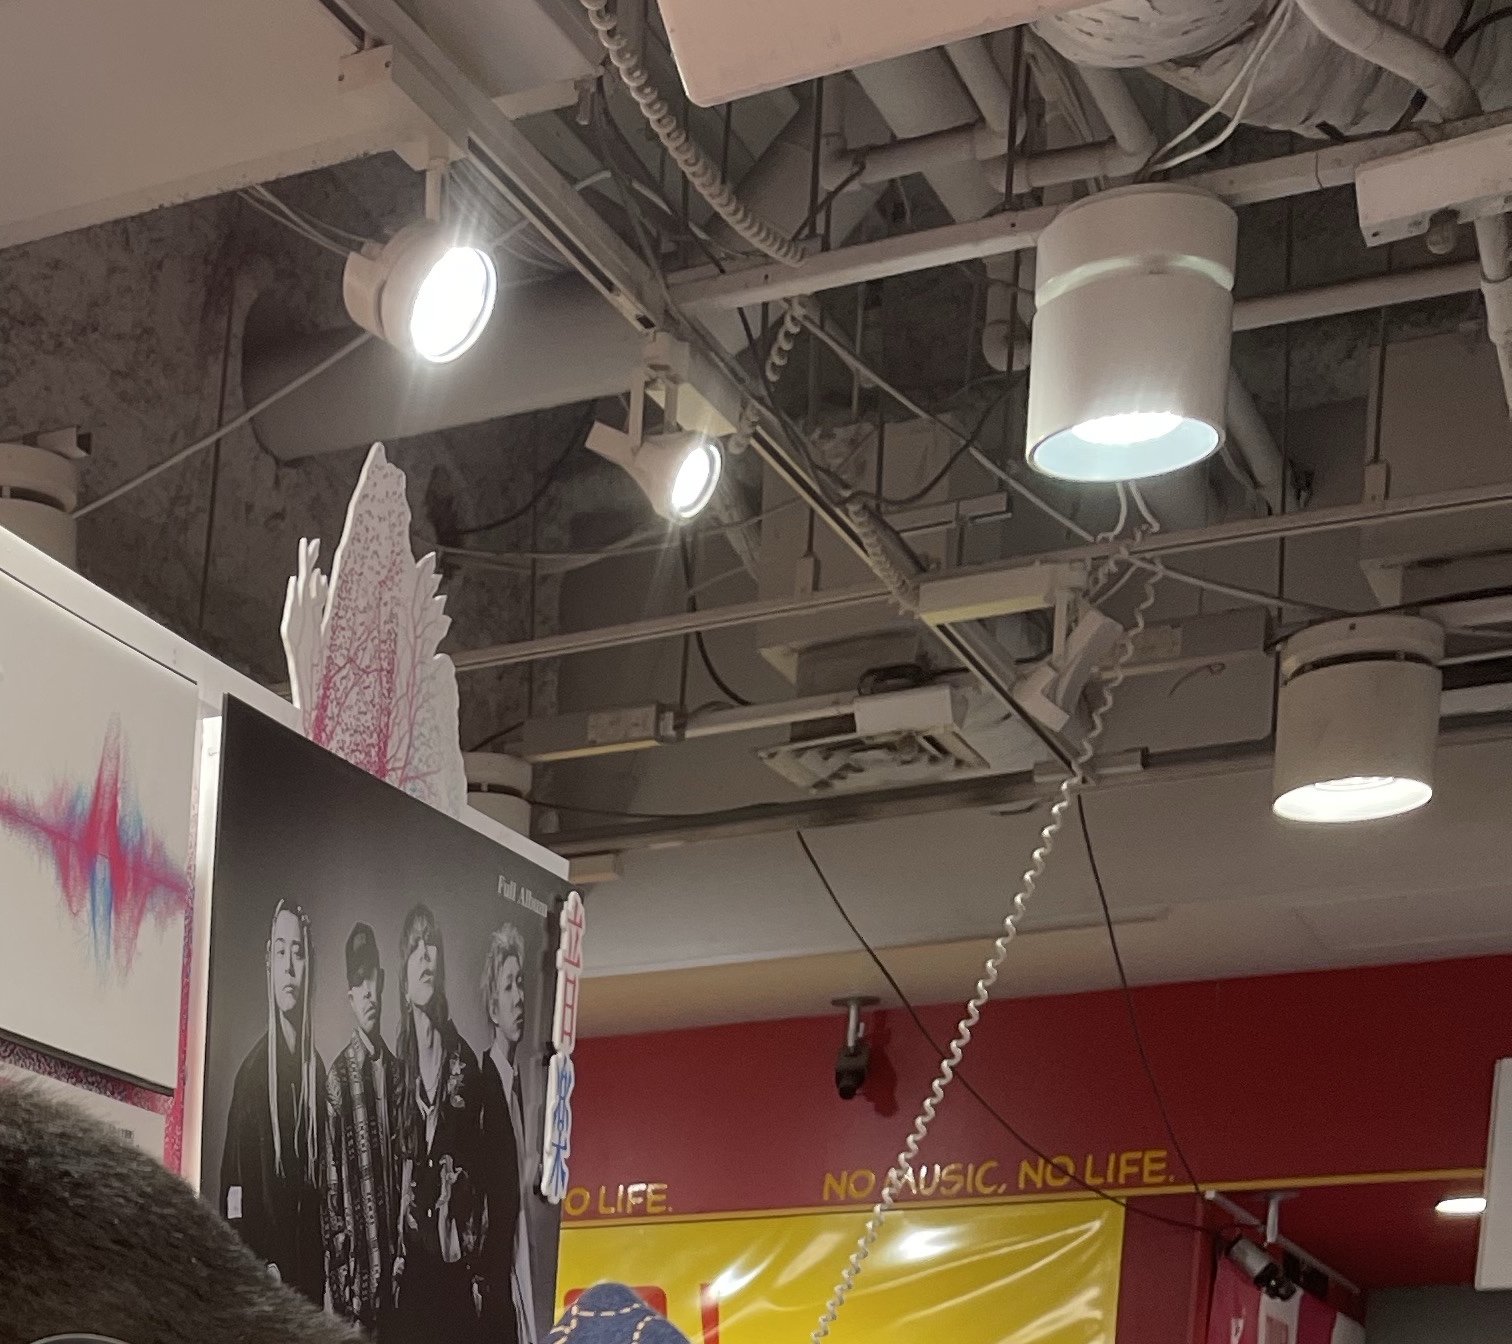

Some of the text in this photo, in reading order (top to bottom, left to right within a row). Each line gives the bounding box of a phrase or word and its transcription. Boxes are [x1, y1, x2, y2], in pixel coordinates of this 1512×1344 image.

[498, 874, 517, 901] Full
[822, 1148, 1175, 1202] NO MUSIC, NO LIFE.
[599, 1182, 674, 1215] LIFE.
